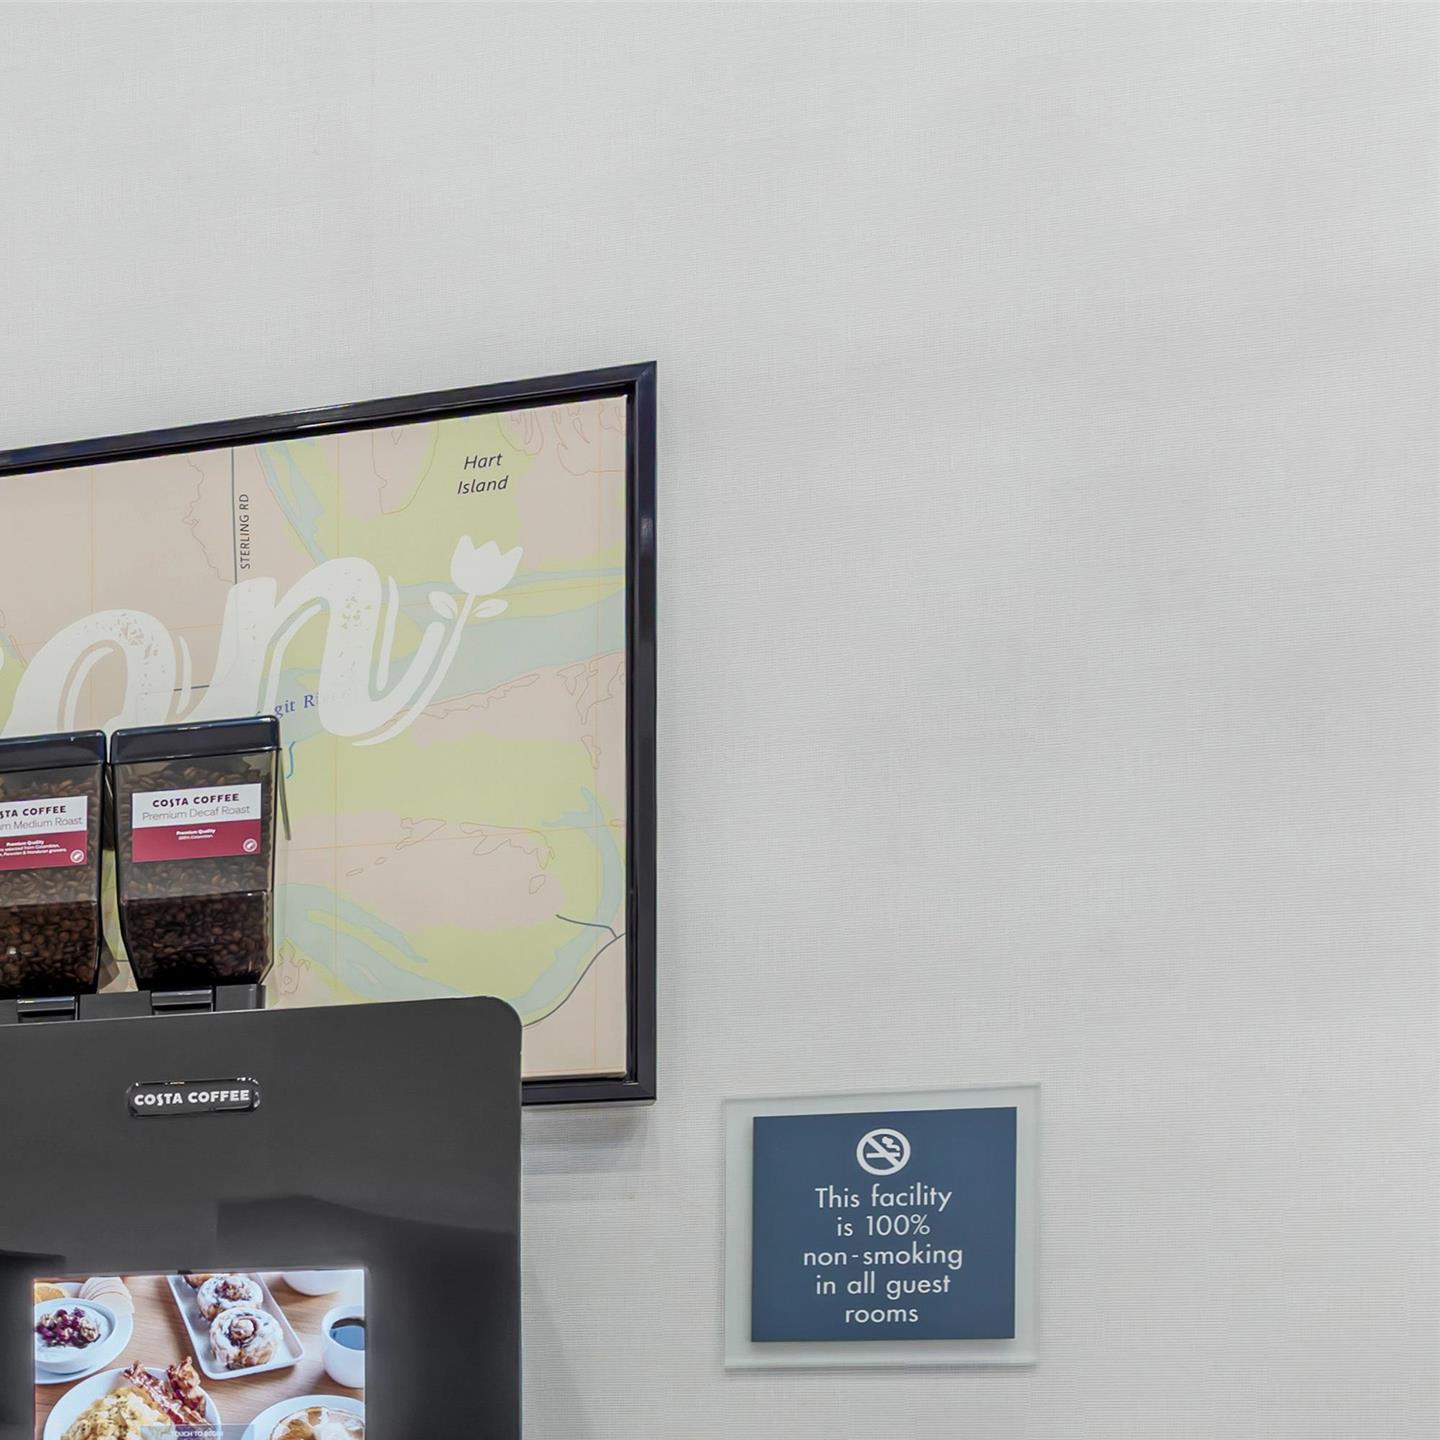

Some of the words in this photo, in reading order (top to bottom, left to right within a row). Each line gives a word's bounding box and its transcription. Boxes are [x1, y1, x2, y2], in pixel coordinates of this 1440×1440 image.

[464, 452, 503, 470] Hart
[457, 475, 509, 495] Island
[239, 494, 249, 510] RD
[239, 515, 250, 569] STERLING
[153, 798, 188, 807] COSTA
[194, 794, 239, 804] COFFEE
[23, 805, 66, 816] COFFEE
[143, 811, 187, 820] Premium
[189, 808, 218, 817] Decaf
[222, 805, 250, 815] Roast
[14, 820, 53, 830] Medium
[55, 817, 82, 826] Roast
[134, 1093, 183, 1106] COSTA
[188, 1089, 250, 1103] COFFEE
[815, 1185, 860, 1208] This
[871, 1182, 952, 1212] facility
[837, 1217, 854, 1236] is
[866, 1214, 931, 1236] 100%
[816, 1275, 836, 1294] in
[847, 1271, 875, 1294] all
[886, 1275, 951, 1300] guest
[845, 1307, 919, 1323] rooms
